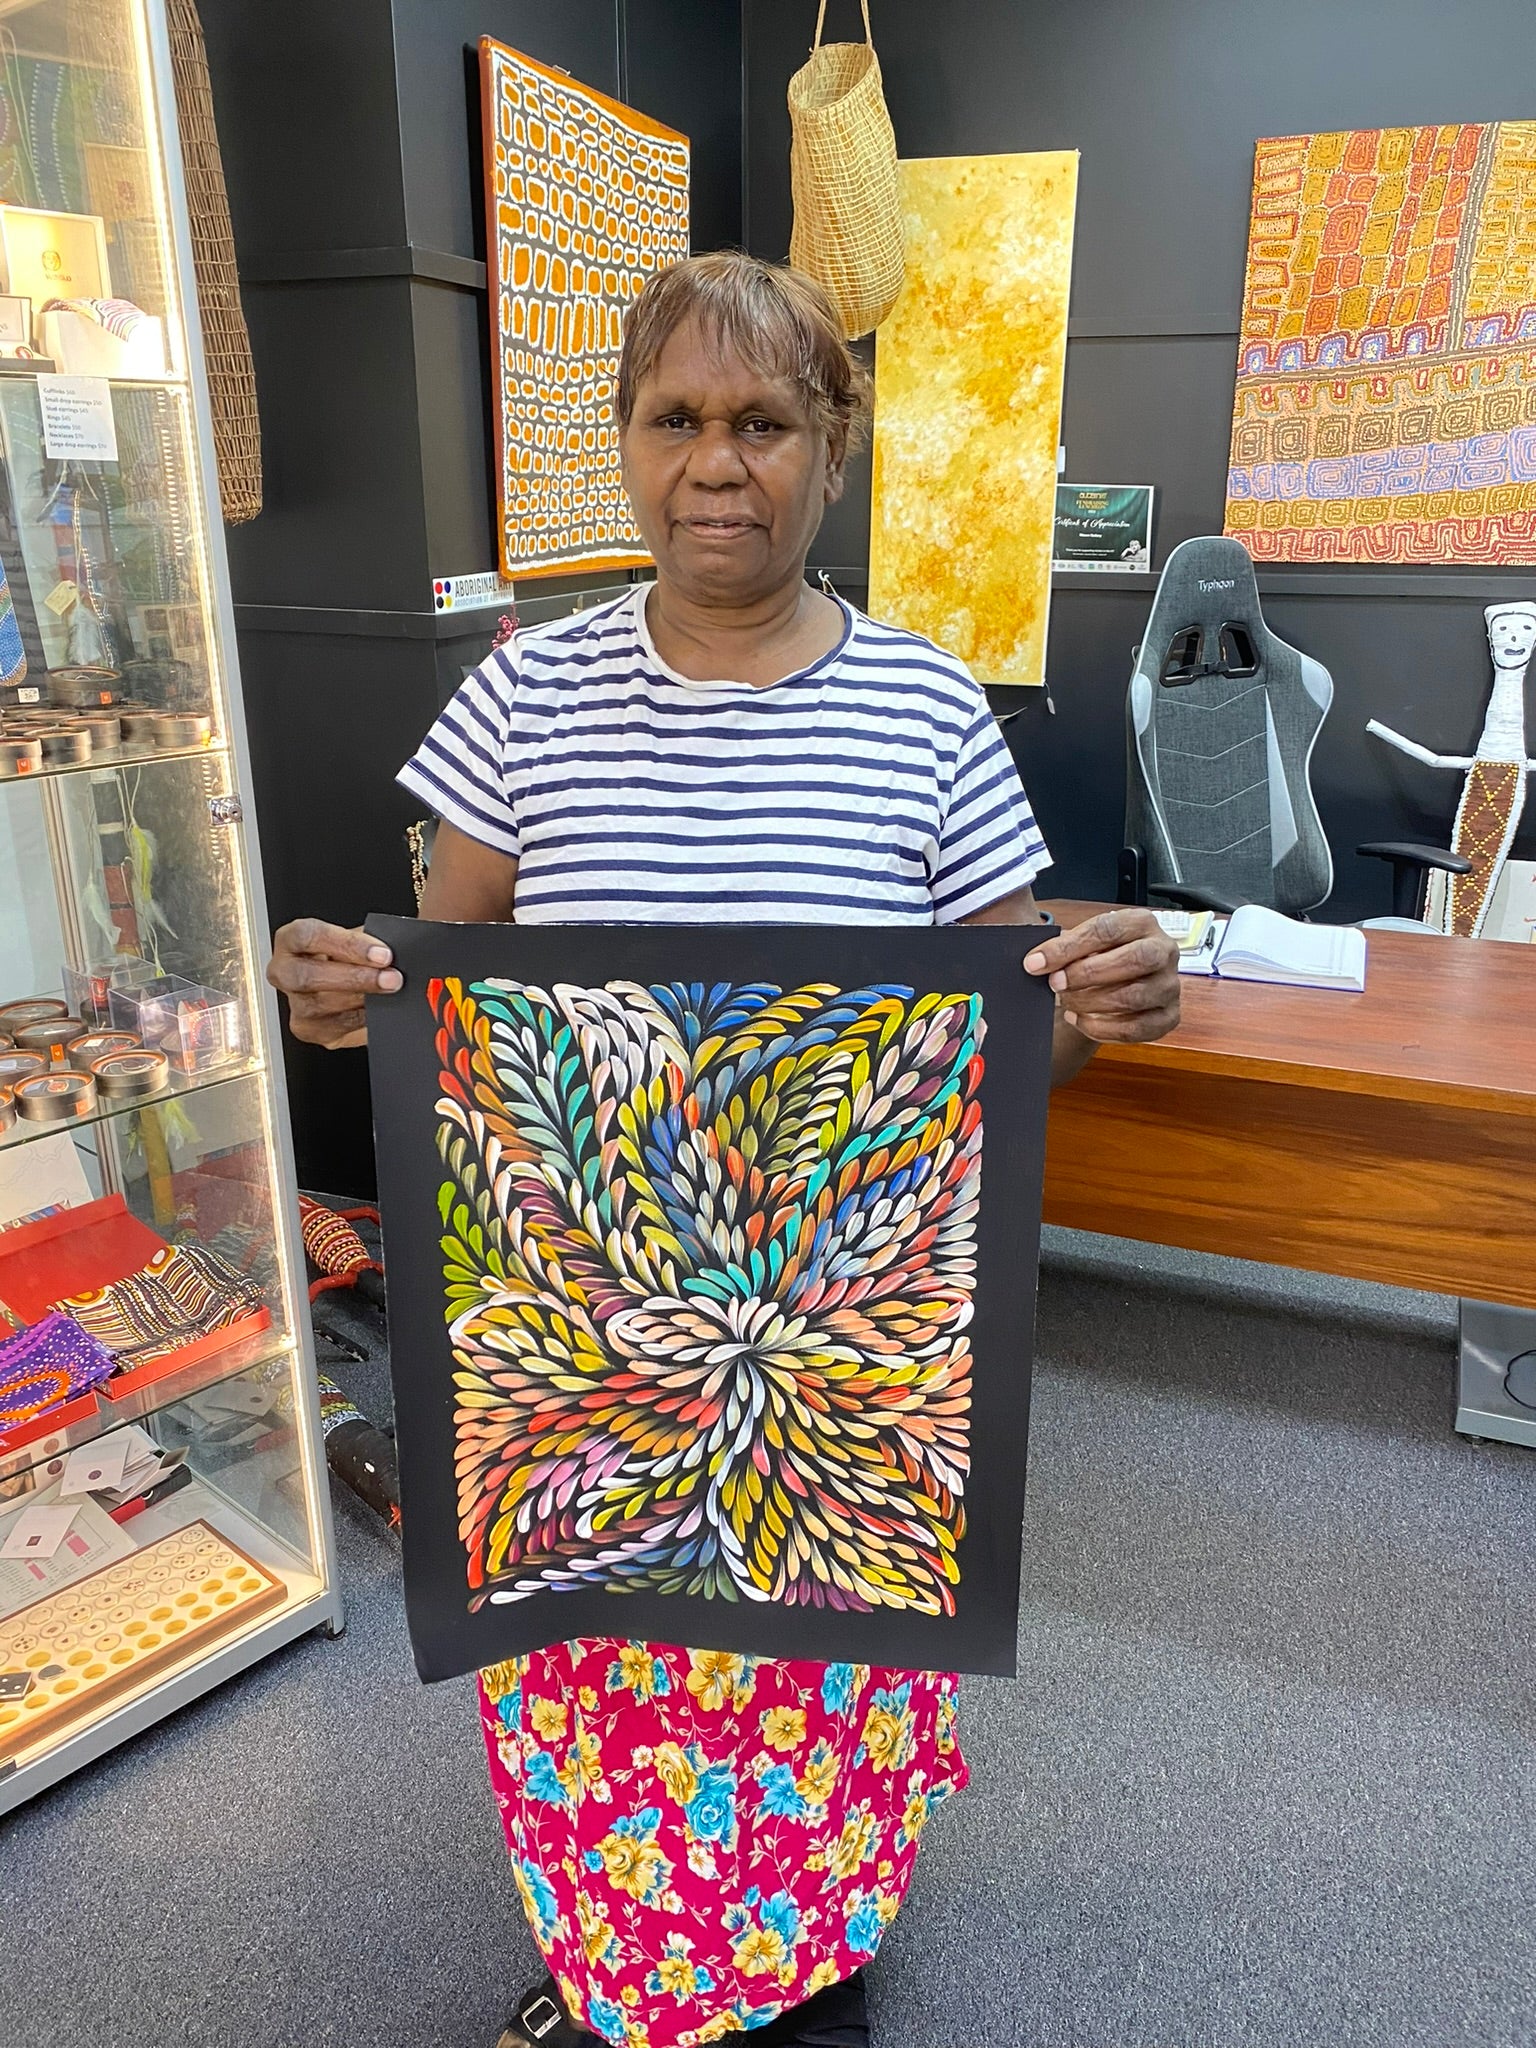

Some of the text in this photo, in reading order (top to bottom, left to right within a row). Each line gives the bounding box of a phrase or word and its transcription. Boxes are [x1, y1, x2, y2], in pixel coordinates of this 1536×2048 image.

[1082, 518, 1090, 528] of
[1090, 517, 1131, 529] Appreciation
[455, 575, 497, 598] ABORIGINAL
[1198, 579, 1235, 592] Typhoon
